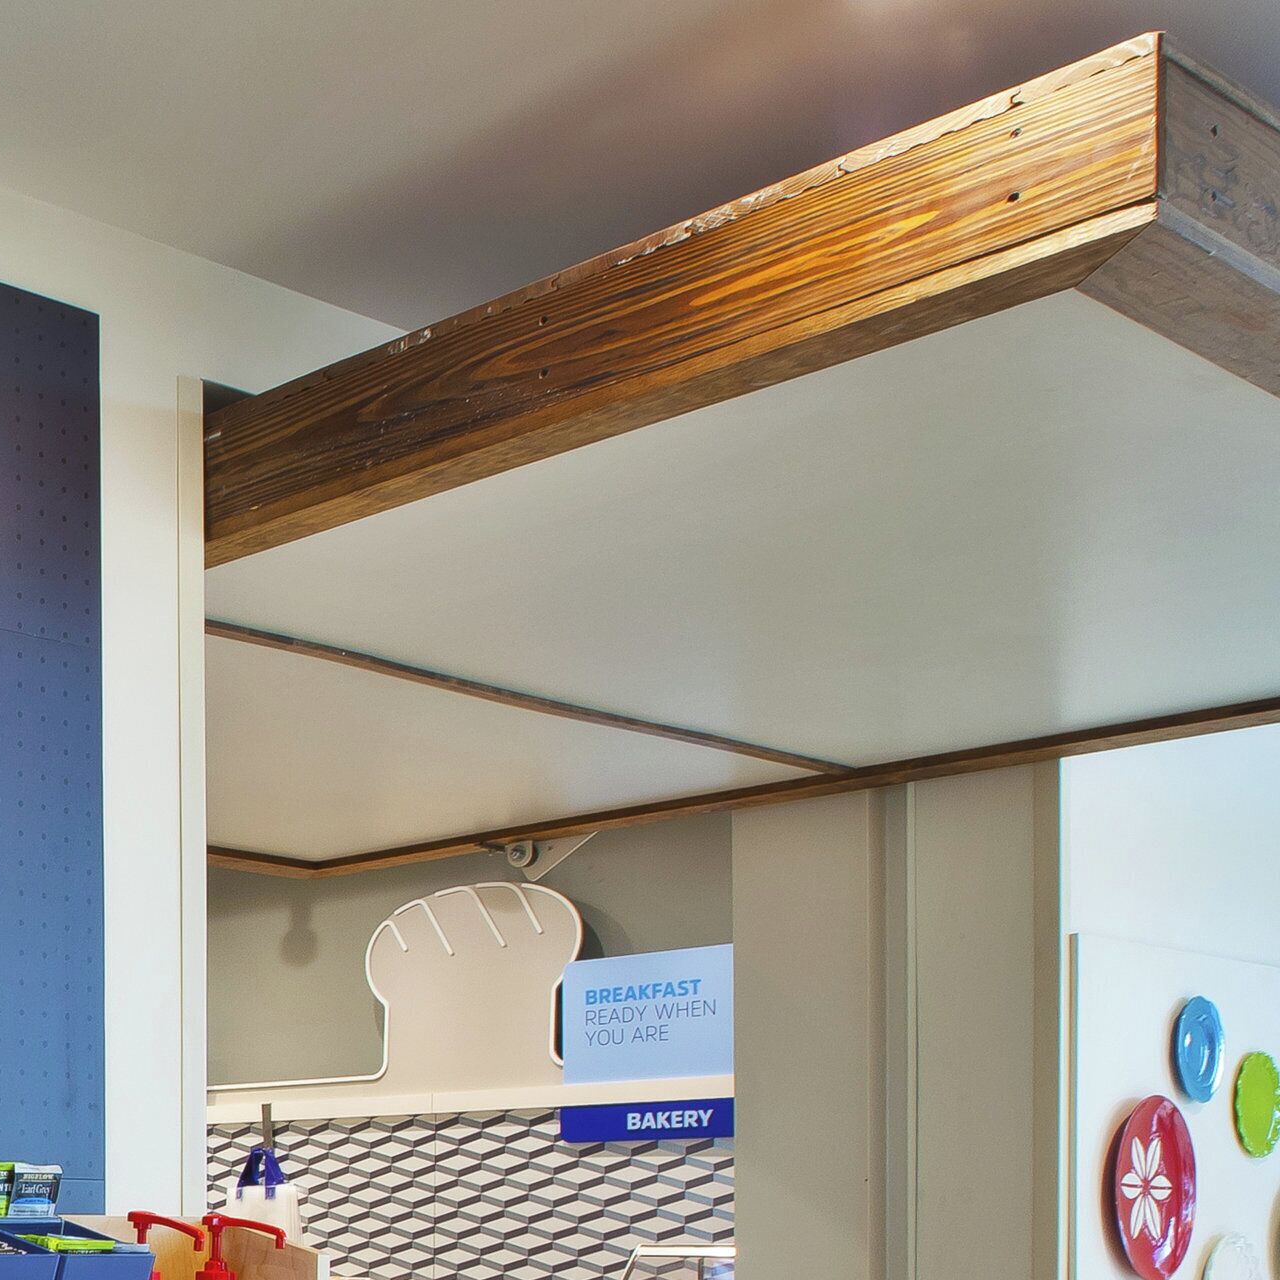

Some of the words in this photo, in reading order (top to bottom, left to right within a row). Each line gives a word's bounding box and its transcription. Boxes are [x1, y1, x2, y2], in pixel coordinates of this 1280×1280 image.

[585, 978, 702, 1006] BREAKFAST
[585, 1005, 648, 1026] READY
[655, 999, 717, 1020] WHEN
[585, 1029, 624, 1046] YOU
[631, 1024, 670, 1043] ARE
[626, 1109, 714, 1131] BAKERY
